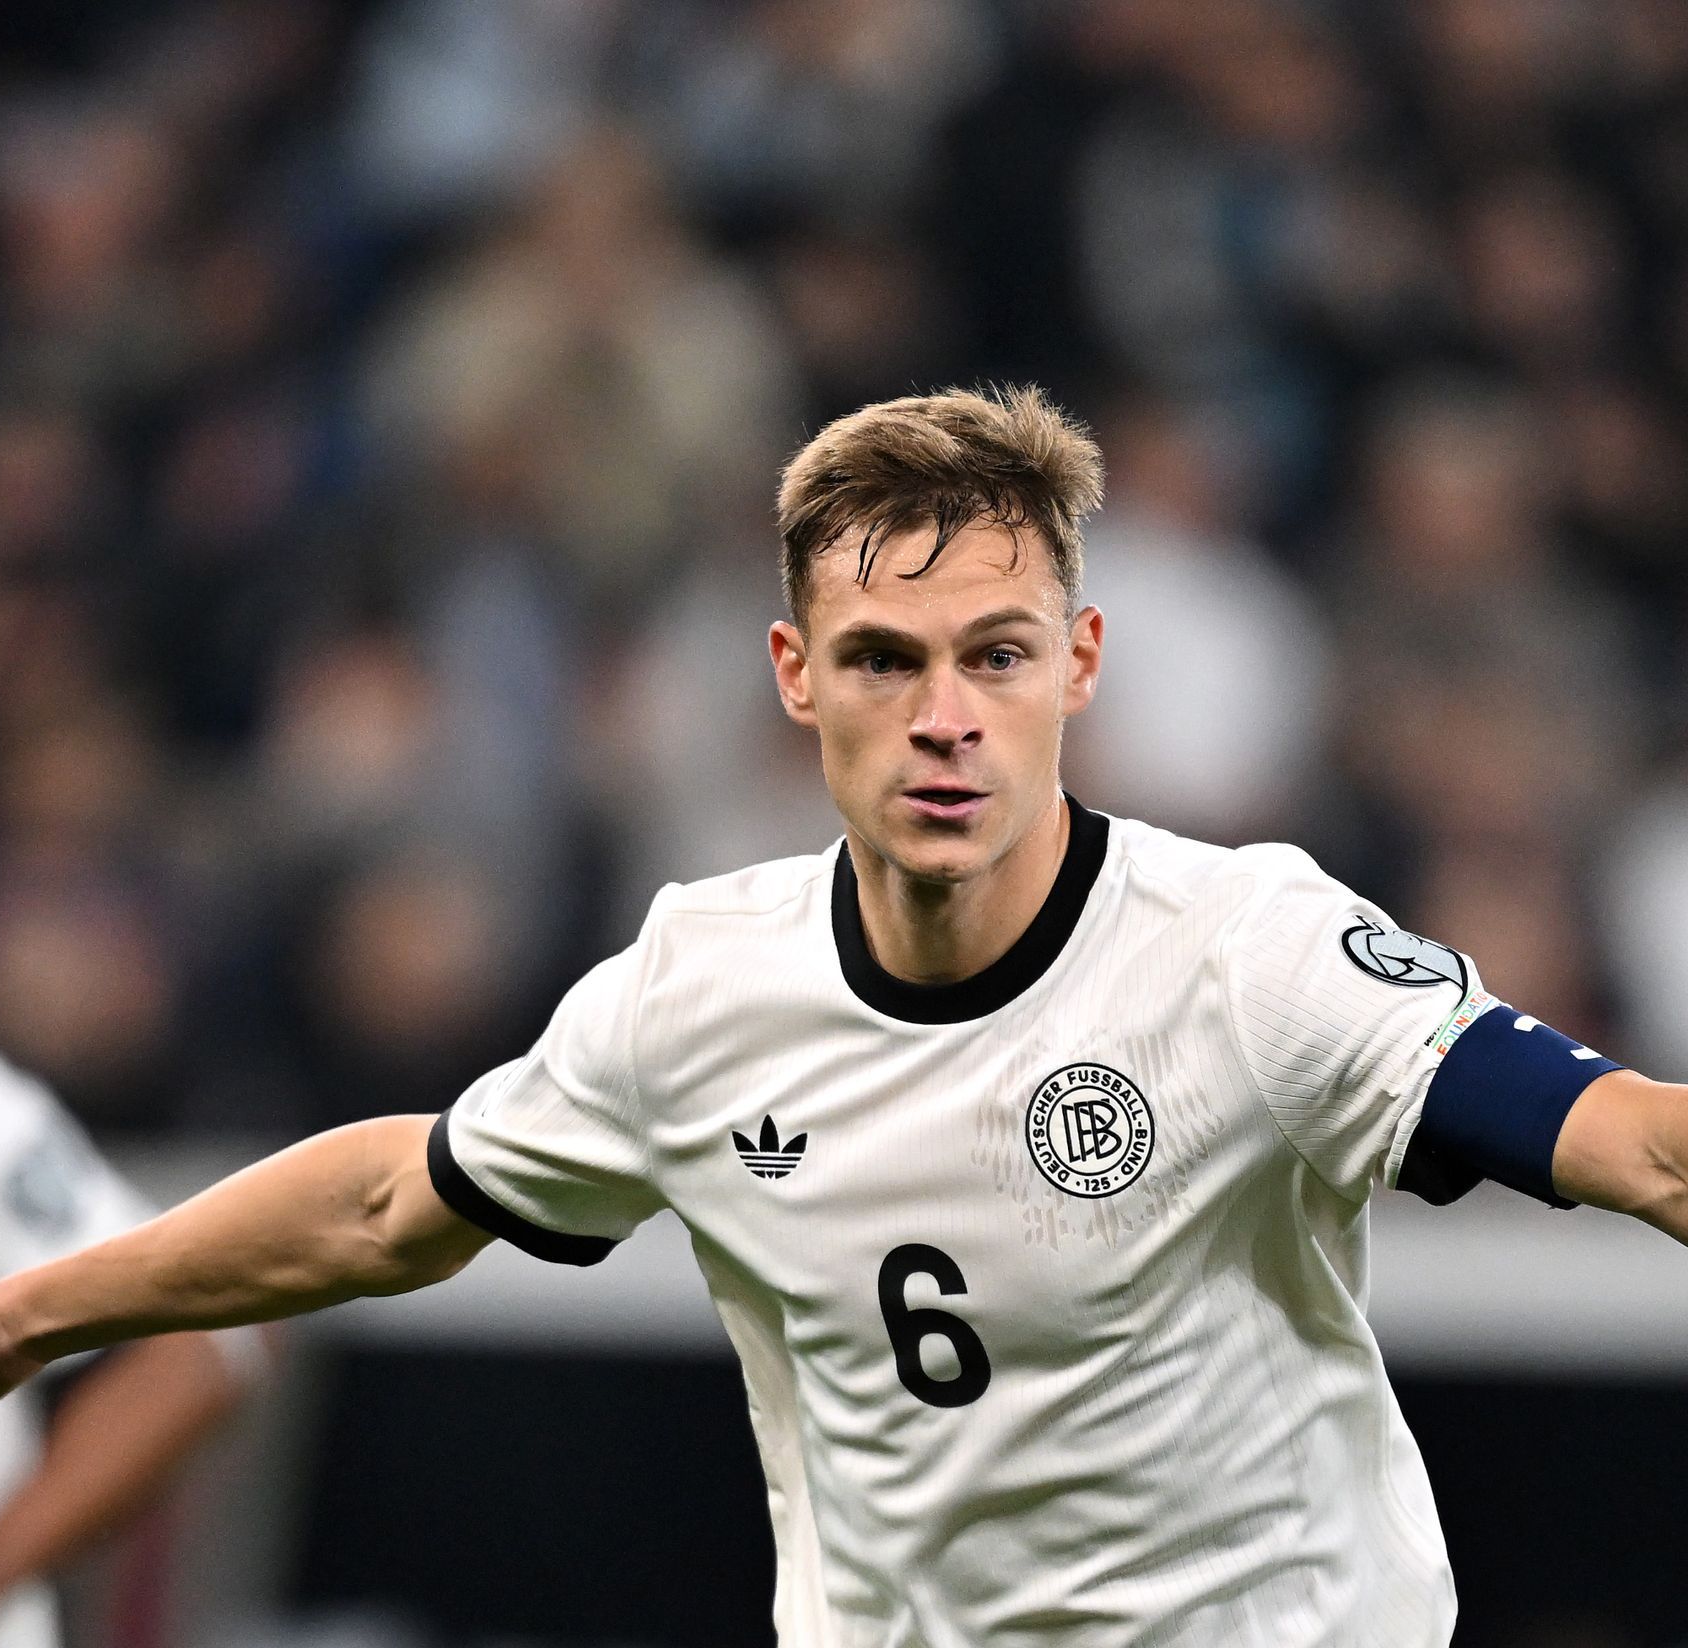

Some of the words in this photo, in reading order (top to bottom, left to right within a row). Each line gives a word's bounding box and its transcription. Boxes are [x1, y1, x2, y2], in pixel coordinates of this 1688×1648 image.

[1033, 1081, 1070, 1183] DEUTSCHER
[1084, 1176, 1111, 1192] 125
[878, 1243, 991, 1408] 6
